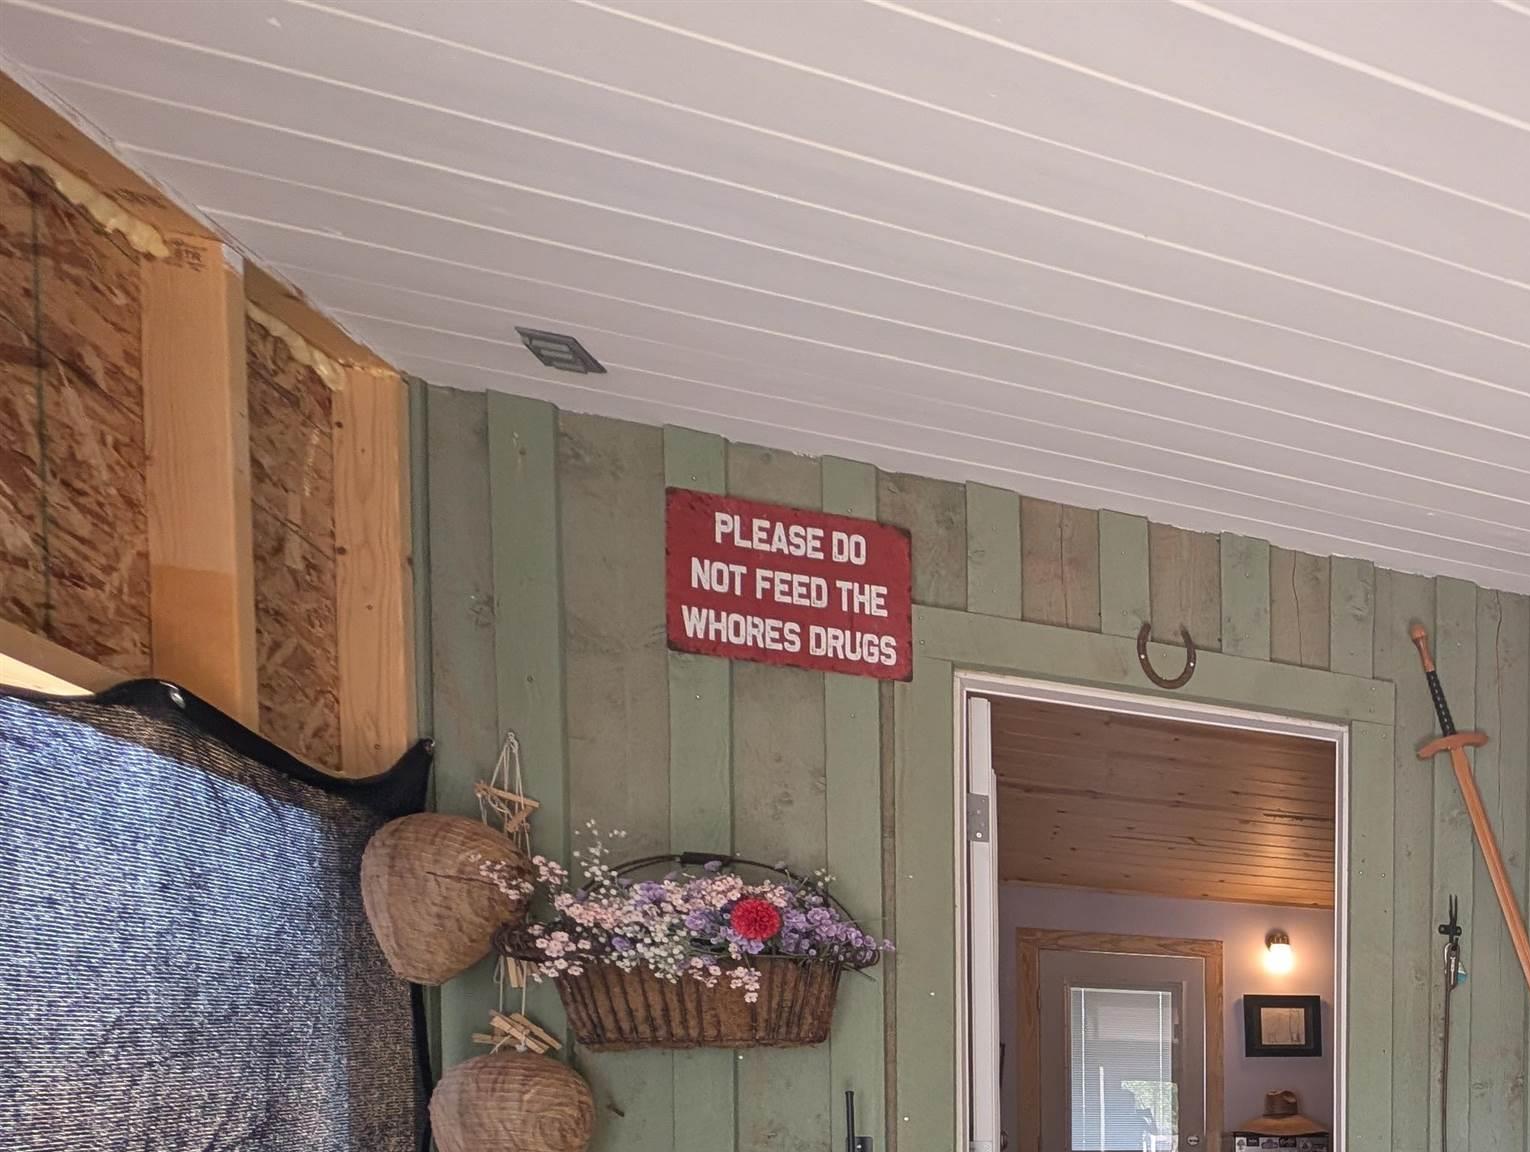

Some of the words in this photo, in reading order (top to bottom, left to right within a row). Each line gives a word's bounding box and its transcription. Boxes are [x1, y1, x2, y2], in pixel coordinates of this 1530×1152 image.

[714, 511, 824, 560] PLEASE
[831, 531, 867, 565] DO
[690, 556, 747, 596] NOT
[755, 568, 829, 608] FEED
[836, 579, 888, 617] THE
[681, 604, 801, 653] WHORES
[808, 625, 897, 666] DRUGS
